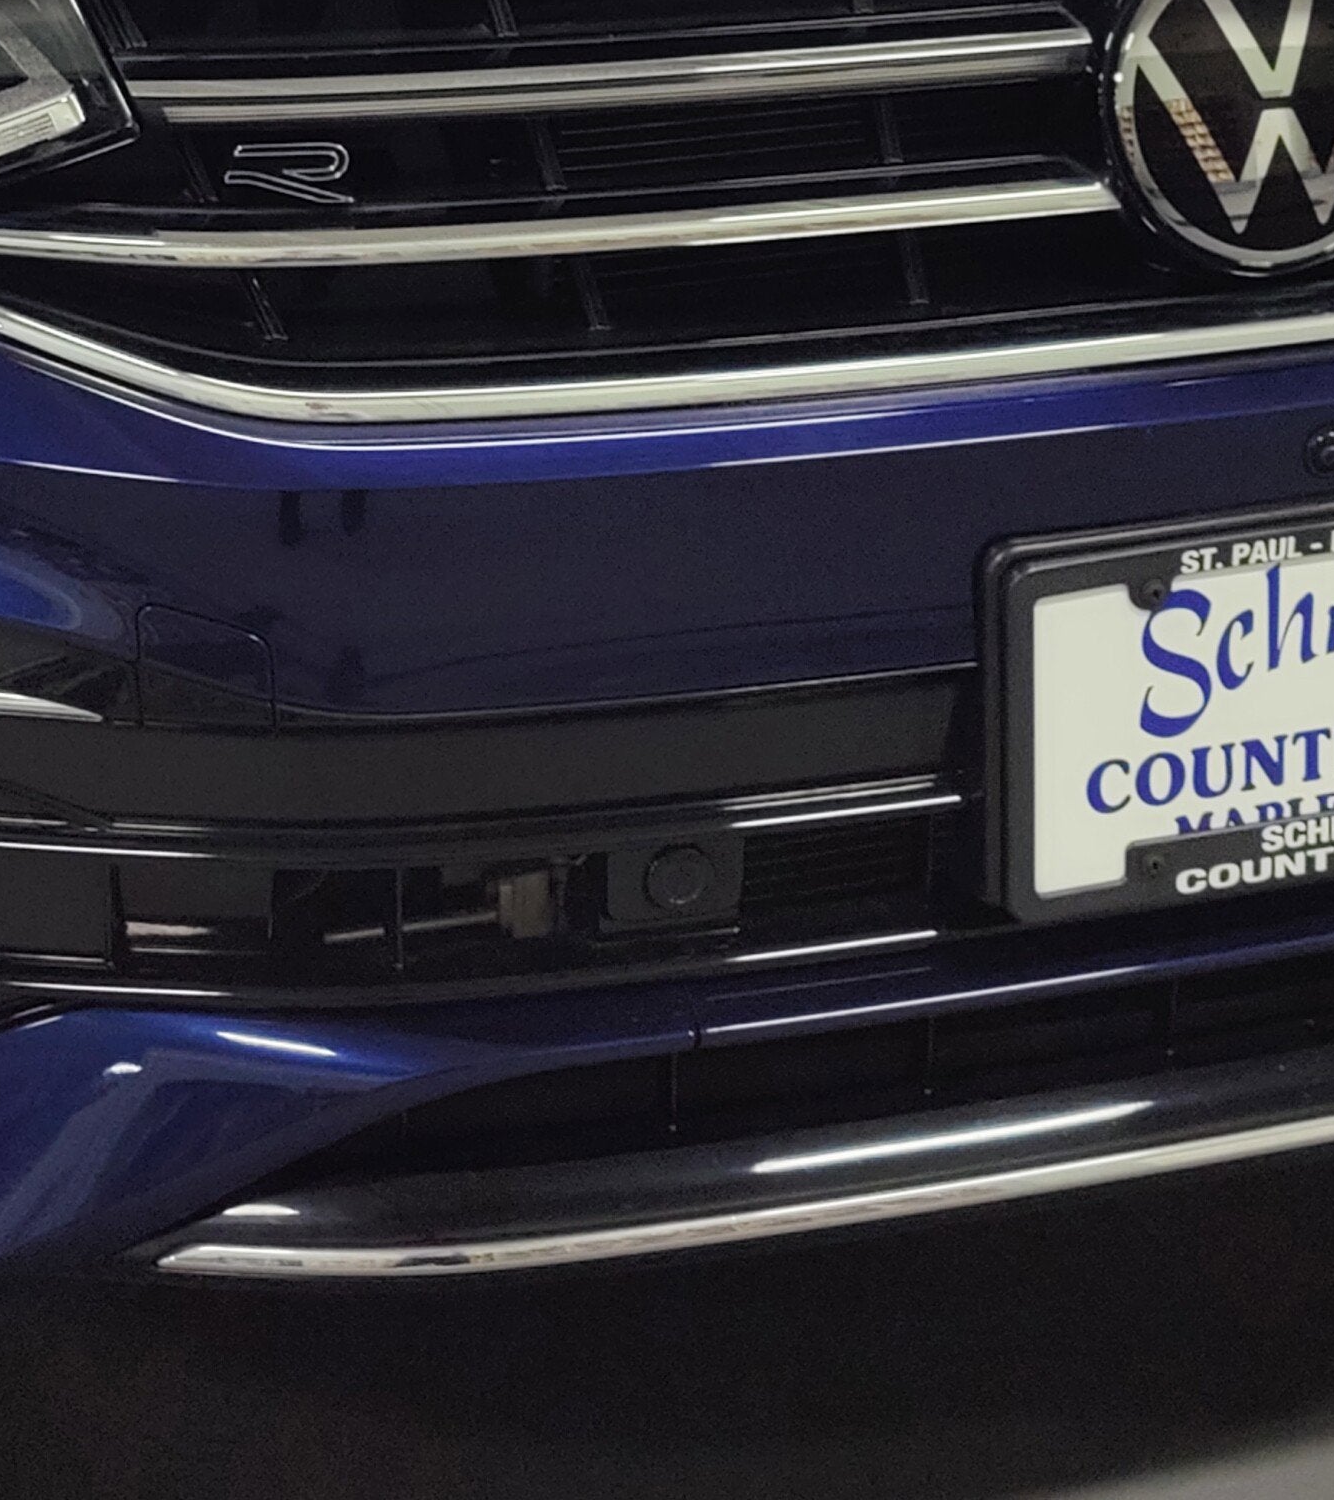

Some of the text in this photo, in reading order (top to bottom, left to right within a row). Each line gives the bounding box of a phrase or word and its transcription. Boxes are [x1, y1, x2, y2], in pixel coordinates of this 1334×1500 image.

[224, 142, 354, 203] R
[1180, 546, 1224, 575] ST.
[1231, 535, 1303, 566] PAUL
